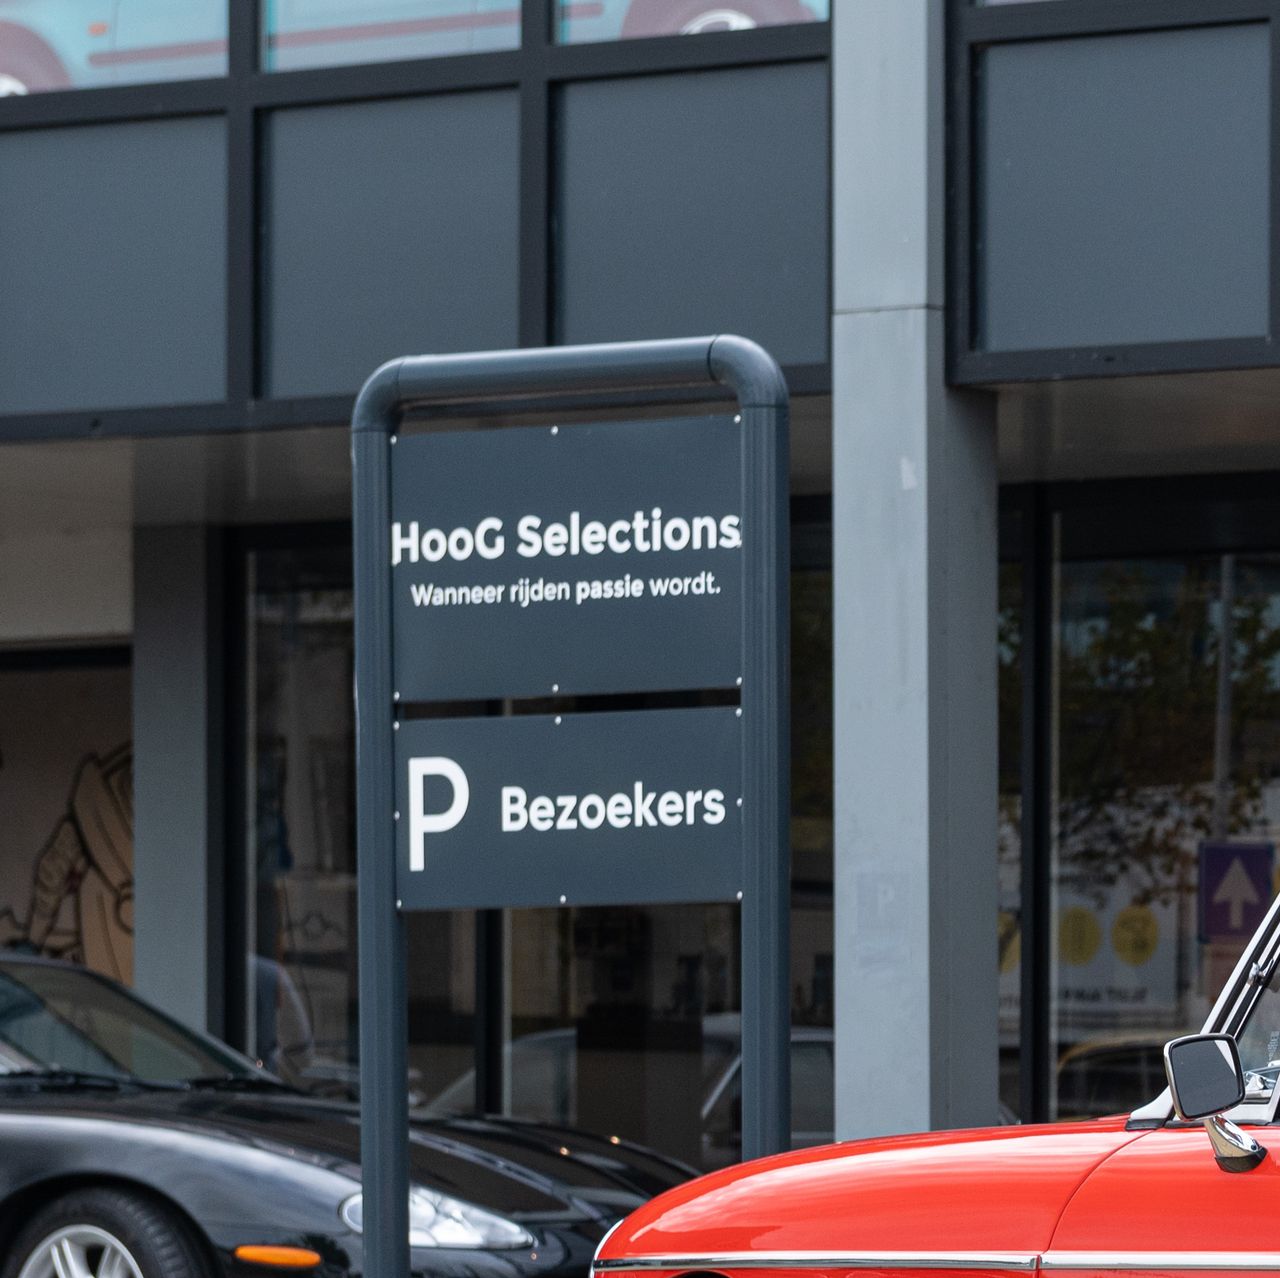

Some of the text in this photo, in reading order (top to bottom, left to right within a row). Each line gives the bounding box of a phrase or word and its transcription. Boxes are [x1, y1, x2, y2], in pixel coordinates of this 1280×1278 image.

[392, 507, 741, 564] HooG Selections
[410, 570, 721, 608] Wanneer rijden passie wordt.
[408, 756, 726, 872] P Bezoekers
